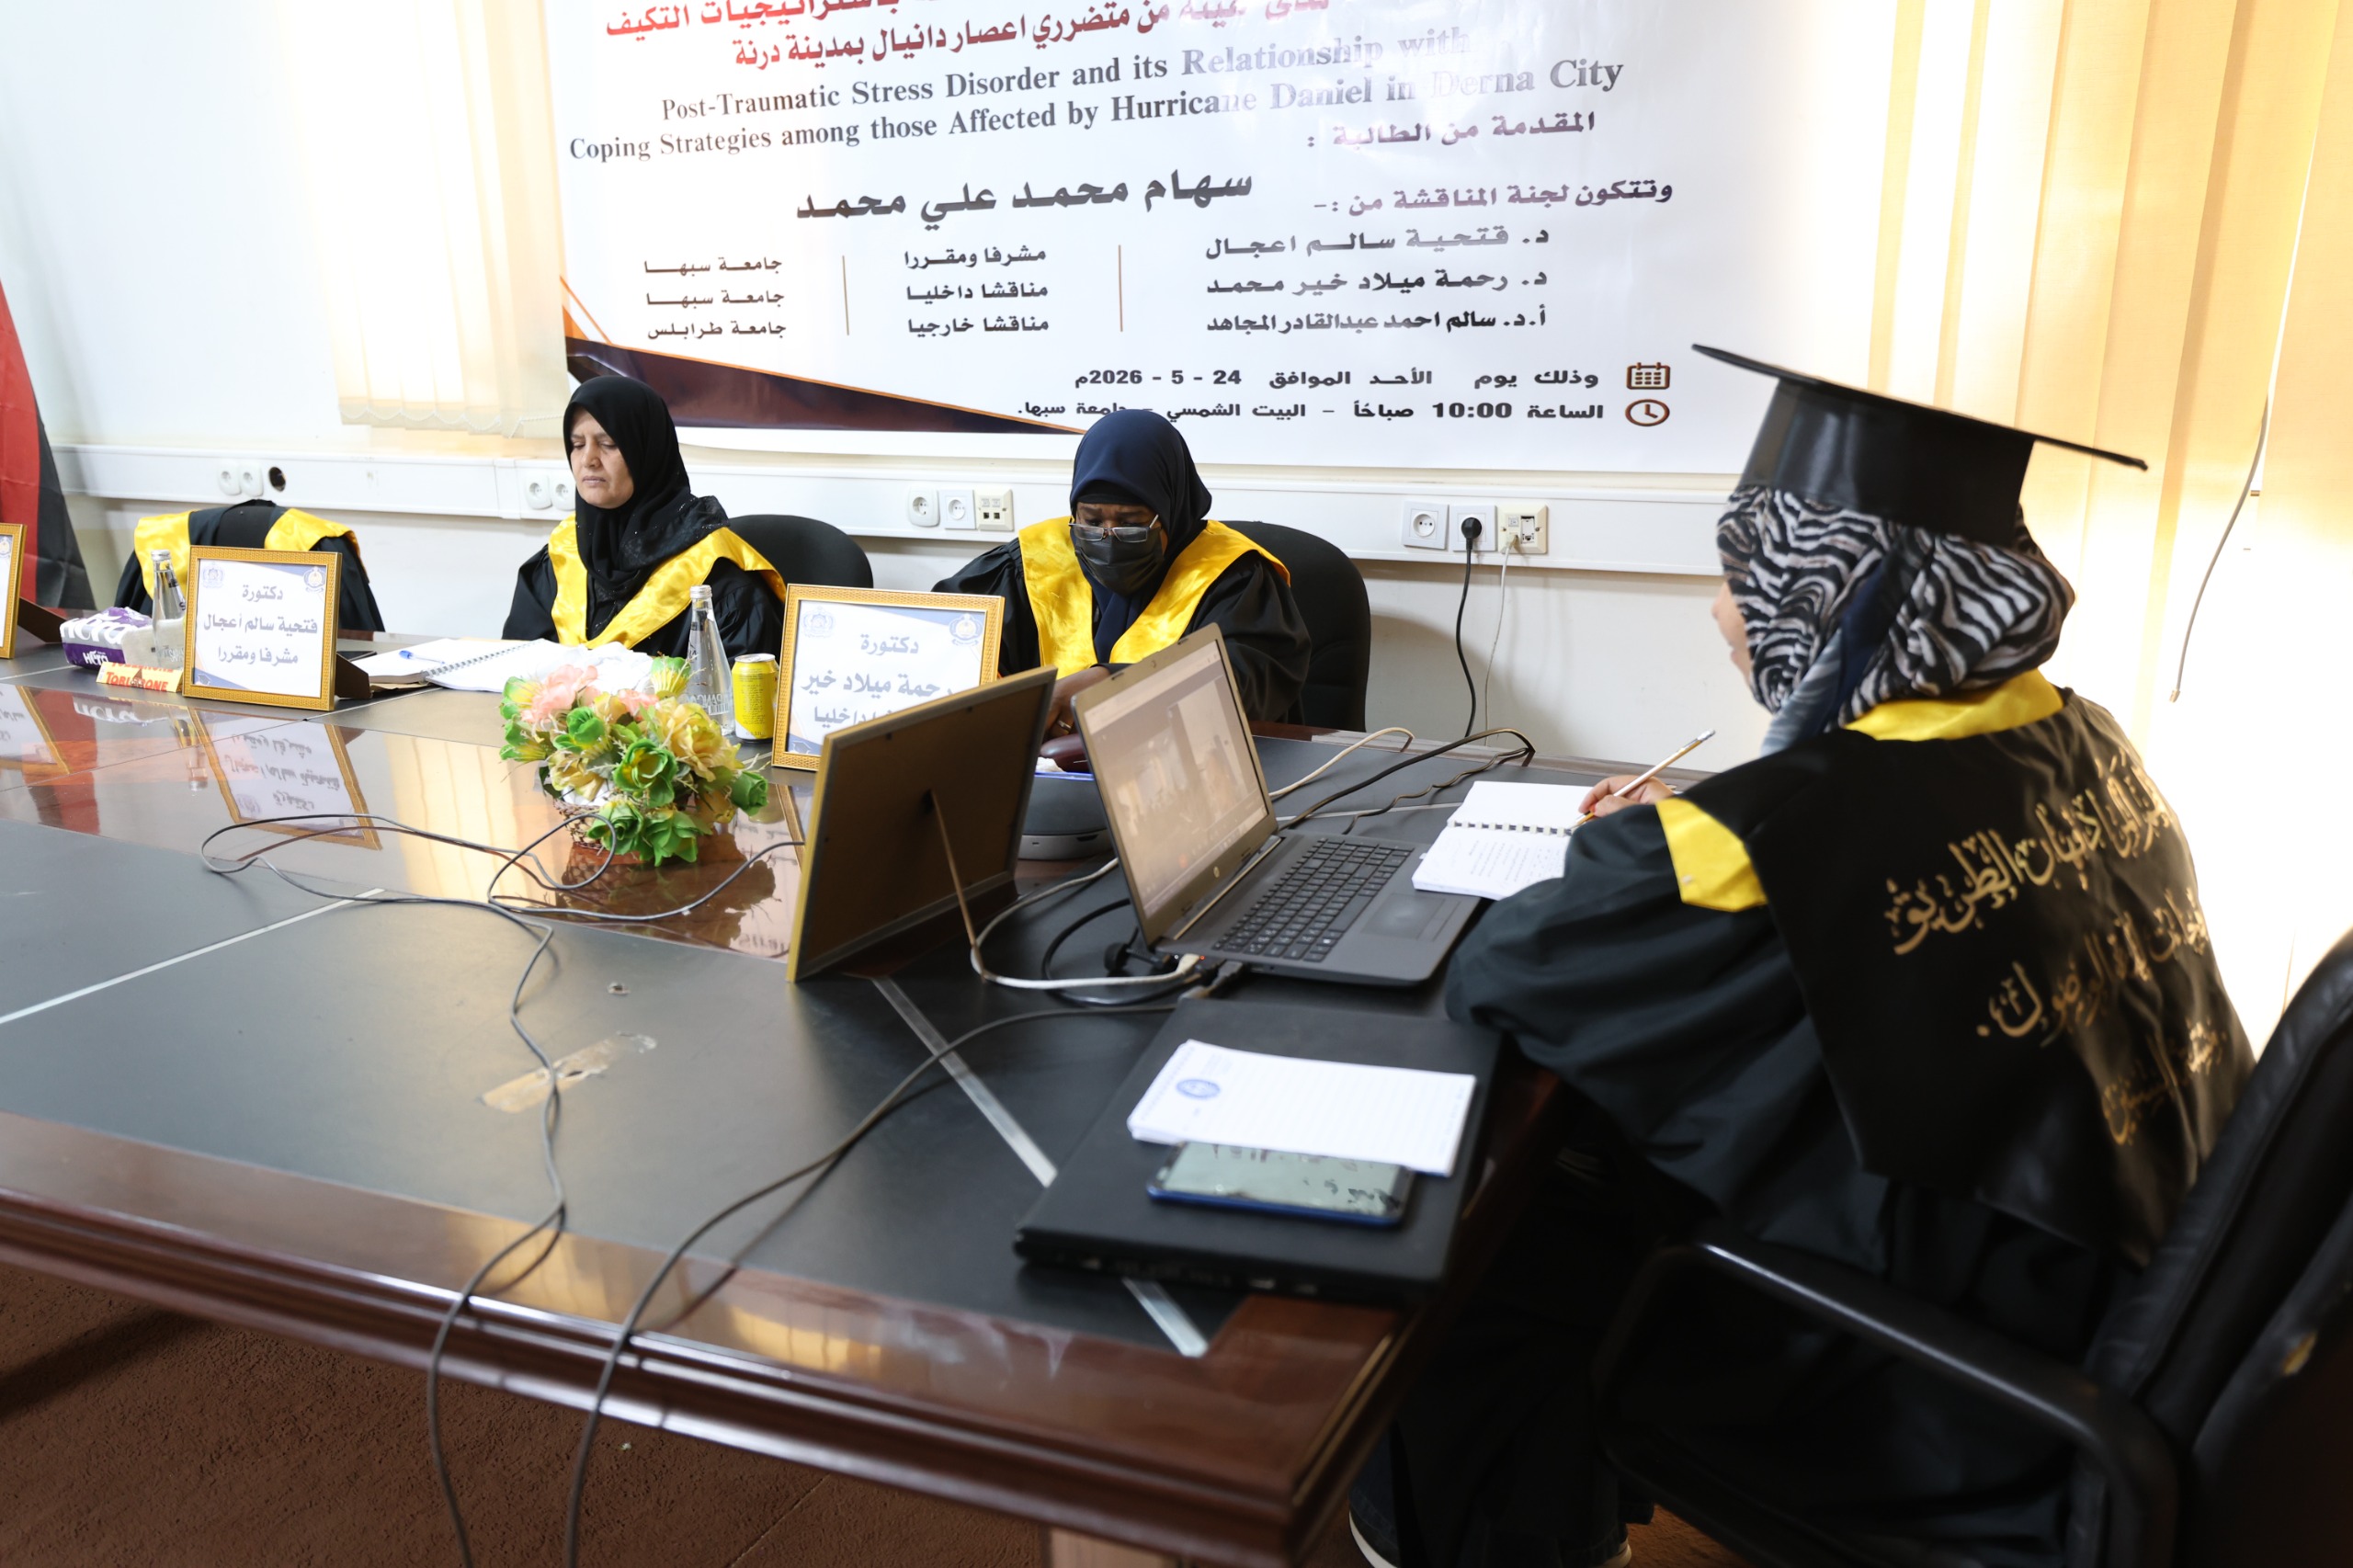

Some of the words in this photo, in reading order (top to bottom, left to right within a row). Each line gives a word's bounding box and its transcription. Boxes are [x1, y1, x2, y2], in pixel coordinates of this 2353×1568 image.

[607, 6, 689, 41] التكيف
[949, 15, 1026, 53] اعصار
[1033, 2, 1130, 50] متضرري
[786, 34, 864, 68] بمدينة
[872, 24, 947, 62] دانيال
[733, 40, 780, 70] درنة
[663, 85, 840, 120] Post-Traumatic
[852, 82, 933, 104] Stress
[946, 66, 1060, 97] Disorder
[1073, 57, 1120, 85] and
[1133, 54, 1167, 80] its
[1181, 35, 1383, 76] Relationship
[1397, 26, 1468, 52] with
[570, 137, 651, 163] Coping
[660, 129, 771, 154] Strategies
[782, 125, 859, 147] among
[870, 116, 937, 140] those
[949, 102, 1056, 134] Affected
[1068, 101, 1098, 129] by
[1111, 90, 1257, 121] Hurricane
[1270, 70, 1372, 109] Daniel
[1386, 76, 1415, 101] in
[1434, 66, 1535, 95] Derna
[1550, 59, 1624, 92] City
[1492, 111, 1595, 136] المقدمة
[1334, 122, 1431, 149] الطالبة
[1441, 123, 1479, 146] من
[1012, 182, 1129, 208] محمد
[1144, 169, 1252, 212] سهام
[1393, 187, 1496, 209] المناقشة
[1507, 184, 1569, 208] لجنة
[1575, 179, 1673, 206] وتتكون
[797, 195, 906, 219] محمد
[921, 183, 996, 231] علي
[1348, 196, 1382, 217] من
[1206, 235, 1296, 260] اعجال
[1307, 233, 1395, 256] سالم
[719, 257, 782, 274] جامعة
[904, 249, 977, 269] ومقررا
[984, 245, 1046, 267] مشرفا
[644, 261, 710, 277] سبها
[981, 281, 1048, 298] مناقشا
[1207, 279, 1284, 293] محمد
[1292, 273, 1347, 296] خير
[1358, 272, 1425, 293] ميلاد
[1435, 269, 1507, 291] رحمة
[646, 293, 713, 309] سبها
[722, 290, 784, 307] جامعة
[906, 285, 973, 304] داخليا
[731, 321, 786, 338] جامعة
[908, 318, 974, 337] خارجيا
[983, 315, 1049, 332] مناقشا
[1207, 314, 1277, 335] المجاهد
[1384, 312, 1440, 328] احمد
[1446, 311, 1496, 333] سالم
[648, 322, 722, 340] طرابلس
[1172, 369, 1184, 384] 5
[1213, 369, 1242, 384] 24
[1269, 371, 1350, 389] الموافق
[1370, 367, 1432, 384] الأحد
[1474, 375, 1517, 389] يوم
[1534, 369, 1598, 389] وذلك
[1166, 403, 1240, 423] الشمسي
[1252, 403, 1305, 420] البيت
[1432, 403, 1512, 418] 10:00
[1528, 404, 1603, 418] الساعة
[242, 585, 283, 602] دكتورة
[244, 617, 274, 633] سالم
[278, 616, 318, 637] فتحية
[218, 645, 256, 665] ومقررا
[860, 633, 919, 656] دكتورة
[259, 647, 299, 666] مشرفا
[801, 669, 836, 696] خير
[843, 672, 892, 699] ميلاد
